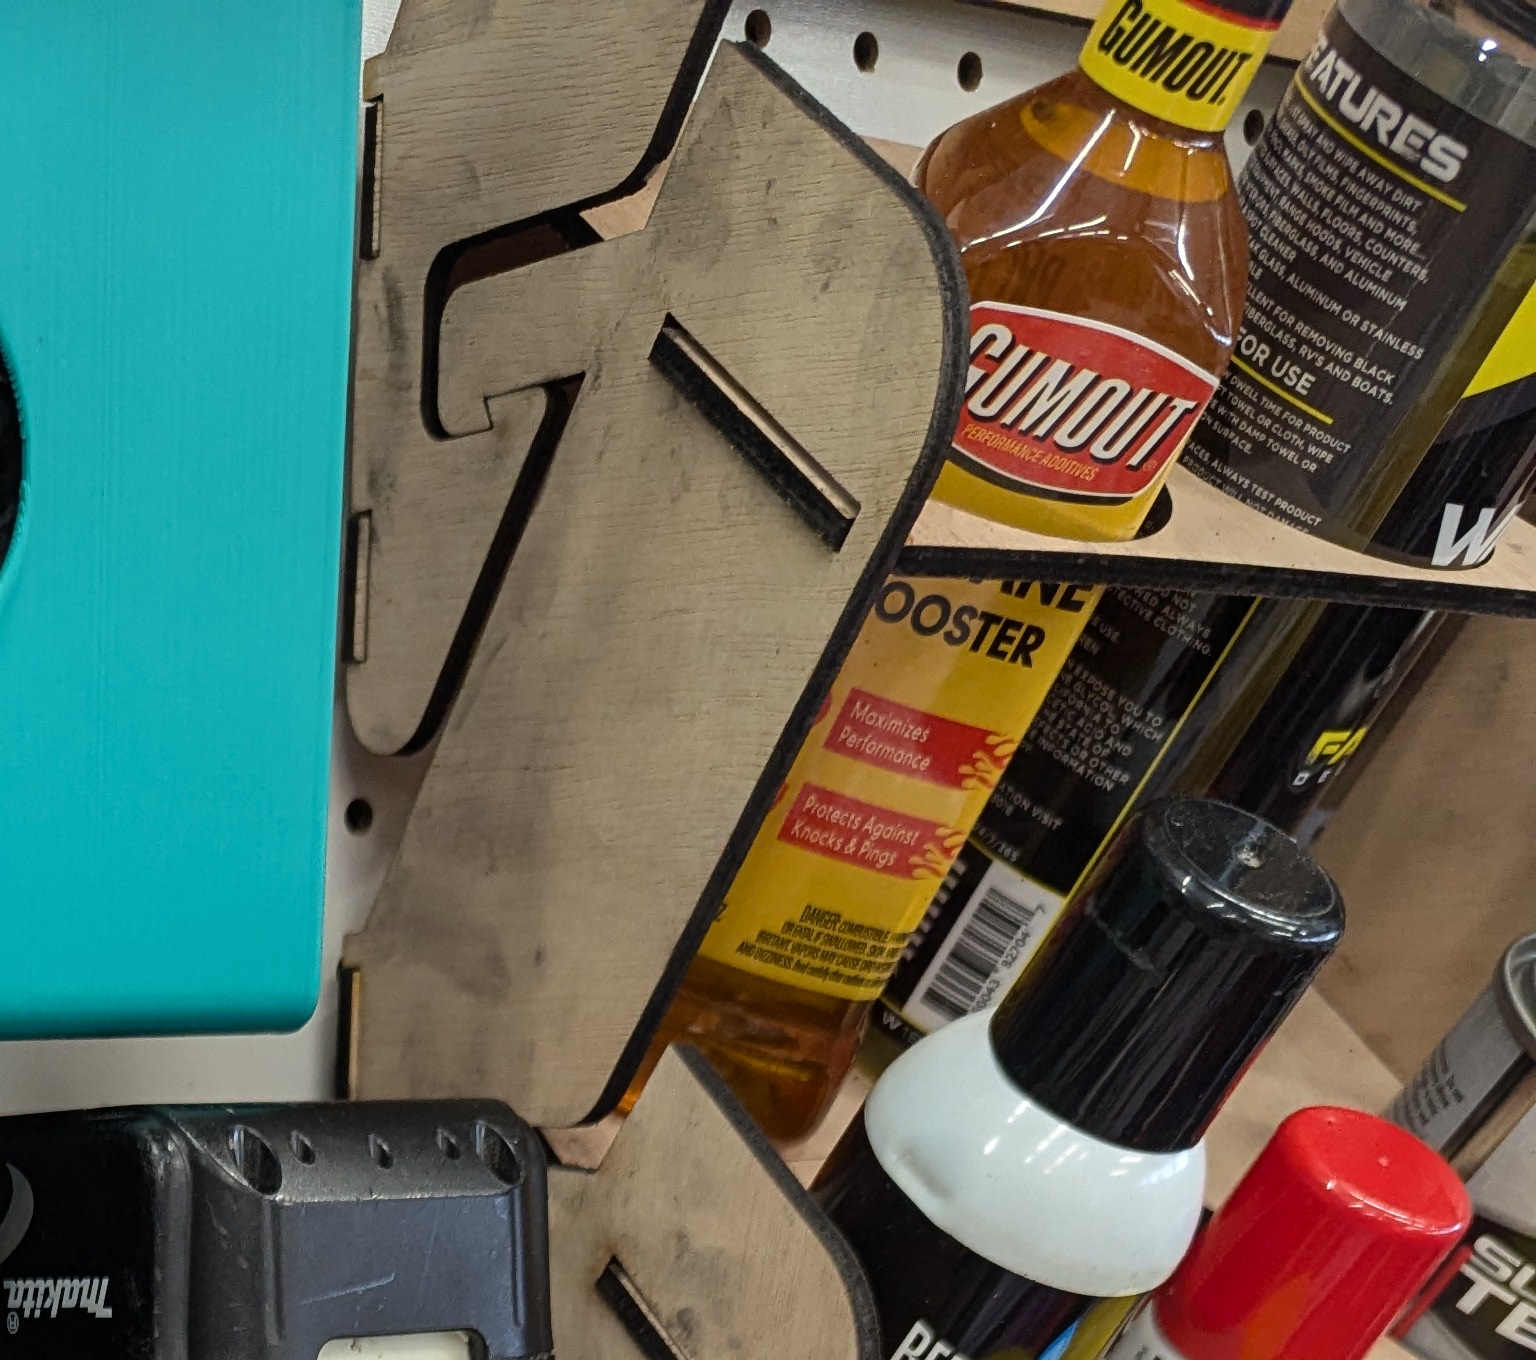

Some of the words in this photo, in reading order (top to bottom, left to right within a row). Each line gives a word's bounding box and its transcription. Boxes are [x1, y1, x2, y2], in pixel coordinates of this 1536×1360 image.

[1304, 171, 1336, 202] SMOKE
[1334, 194, 1361, 217] FILM
[1358, 212, 1385, 234] AND
[1313, 154, 1340, 185] FILMS,
[1340, 176, 1417, 235] FINGERPRINTS,
[1316, 134, 1336, 154] AND
[1334, 149, 1360, 174] WIPE
[1357, 166, 1394, 195] AWAY
[1391, 186, 1423, 212] DIRT
[1259, 226, 1297, 263] CLEANER
[1268, 210, 1319, 260] FIBERGLASS,
[1319, 254, 1344, 274] AND
[1344, 269, 1408, 311] ALUMINUM
[1278, 195, 1308, 226] RANGE
[1306, 219, 1342, 254] HOODS,
[1345, 245, 1393, 282] VEHICLE
[1290, 182, 1320, 216] WALLS,
[1320, 208, 1363, 247] FLOORS,
[1365, 238, 1429, 284] COUNTERS,
[1258, 250, 1286, 280] GLASS,
[1286, 272, 1342, 315] ALUMINUM
[1341, 309, 1360, 327] OR
[1360, 320, 1425, 361] STAINLESS
[1273, 305, 1295, 327] FOR
[1295, 320, 1353, 364] REMOVING
[1353, 357, 1395, 385] BLACK
[1299, 344, 1325, 368] RV'S
[1324, 361, 1352, 382] AND
[1351, 376, 1395, 404] BOATS.
[965, 322, 1195, 472] GUMOUT
[1270, 355, 1316, 396] USE
[1217, 404, 1240, 426] WITH
[1238, 421, 1266, 442] DAMP
[1266, 438, 1299, 465] TOWEL
[1301, 459, 1318, 473] OR
[1227, 391, 1256, 420] TOWEL
[1256, 413, 1270, 429] OR
[1271, 423, 1306, 451] CLOTH,
[1306, 443, 1334, 464] WIPE
[1230, 375, 1259, 402] DWELL
[1260, 397, 1283, 418] TIME
[1282, 411, 1303, 432] FOR
[1303, 423, 1352, 453] PRODUCT
[962, 424, 1041, 470] PERFORMANCE
[1041, 449, 1098, 483] ADDITIVES
[1211, 459, 1251, 490] ALWAYS
[1251, 483, 1275, 503] TEST
[1274, 497, 1322, 527] PRODUCT
[1162, 605, 1212, 639] ALWAYS
[850, 701, 931, 744] Maximizes
[1118, 695, 1143, 717] YOU
[1146, 711, 1163, 727] TO
[1121, 715, 1163, 743] WHICH
[837, 725, 932, 773] Performance
[1089, 757, 1130, 785] OTHER
[1104, 735, 1133, 757] AND
[791, 820, 843, 853] Knocks
[844, 837, 858, 856] &
[857, 838, 897, 869] Pings
[802, 793, 862, 830] Protects
[862, 816, 920, 847] Against
[1031, 805, 1064, 831] VISIT
